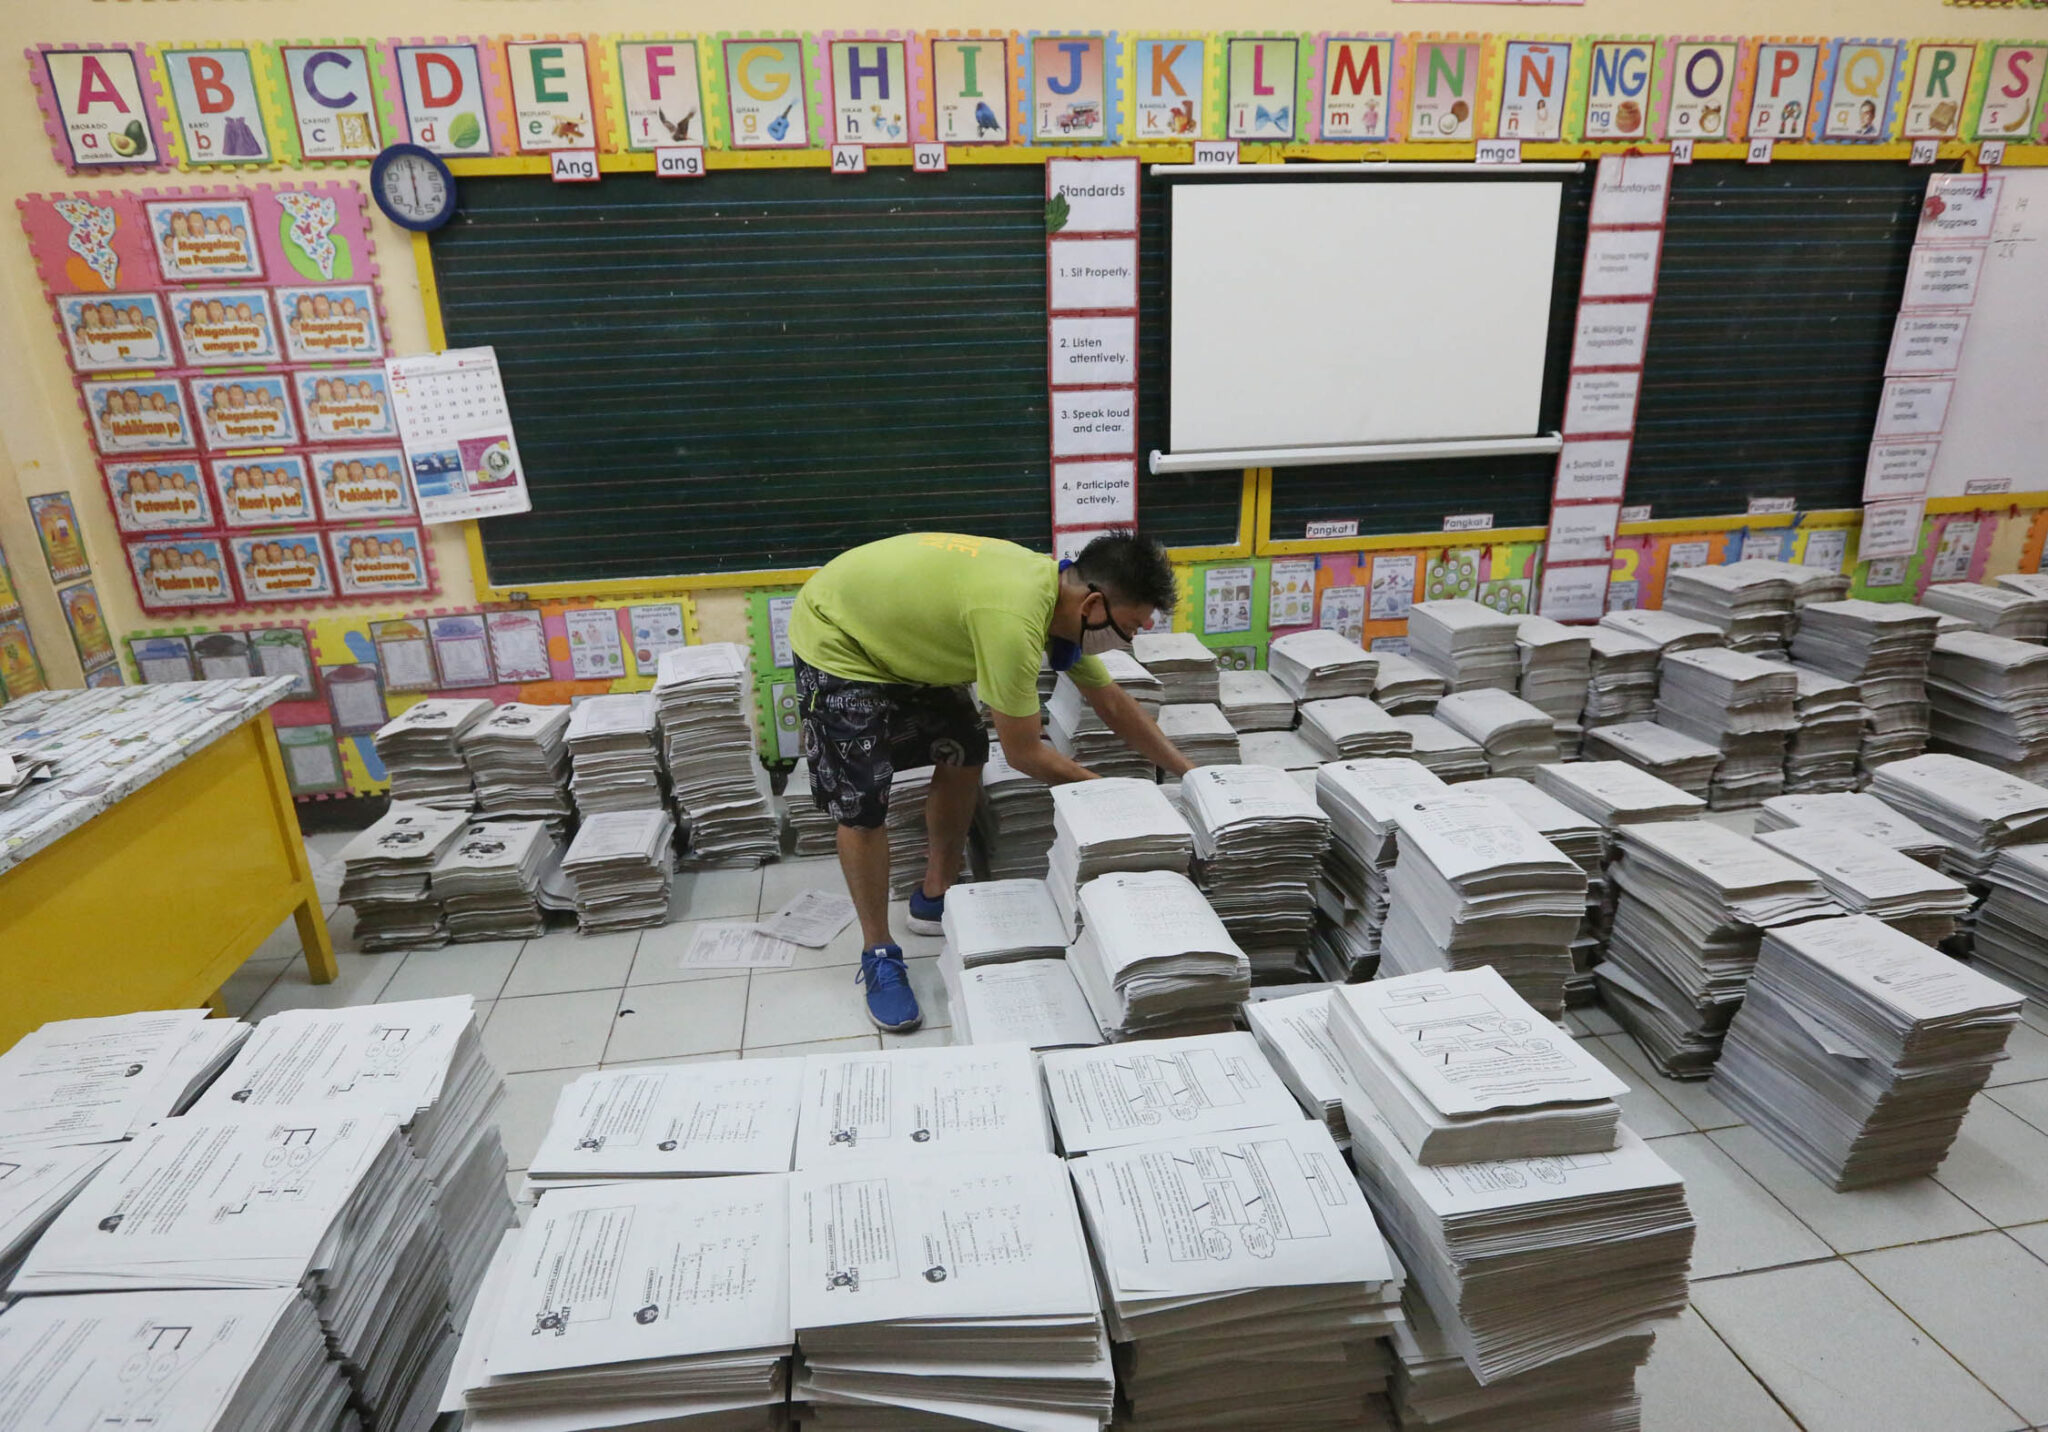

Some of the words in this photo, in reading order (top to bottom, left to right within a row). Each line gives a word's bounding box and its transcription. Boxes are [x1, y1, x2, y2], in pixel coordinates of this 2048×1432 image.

[529, 47, 569, 103] E
[645, 46, 676, 100] F
[737, 45, 791, 101] G
[848, 46, 890, 100] H
[957, 46, 983, 97] I
[1047, 43, 1089, 95] J
[1152, 44, 1187, 97] K
[1253, 45, 1275, 96] L
[1331, 45, 1382, 96] M
[1427, 47, 1467, 98] N
[1518, 46, 1555, 97] Ñ
[1592, 48, 1647, 97] NG
[1685, 48, 1724, 98] O
[1770, 50, 1799, 98] P
[1844, 48, 1885, 98] Q
[1925, 50, 1957, 98] R
[2001, 50, 2034, 98] S
[77, 56, 131, 114] A
[187, 56, 235, 114] B
[303, 51, 358, 109] C
[415, 52, 464, 109] D
[743, 114, 757, 133] g
[847, 115, 859, 133] h
[948, 112, 953, 131] i
[1042, 110, 1048, 129] j
[1147, 110, 1159, 128] k
[1331, 111, 1349, 126] m
[1420, 111, 1432, 126] n
[1508, 113, 1519, 130] ñ
[1590, 110, 1610, 127] ng
[1679, 112, 1690, 125] o
[1757, 110, 1770, 128] p
[1837, 110, 1849, 126] q
[1914, 111, 1923, 124] r
[1989, 110, 2000, 124] s
[421, 123, 436, 143] d
[529, 120, 543, 136] e
[642, 118, 650, 137] f
[81, 133, 99, 149] a
[195, 131, 212, 150] b
[312, 129, 326, 143] c
[1198, 150, 1236, 164] may
[1480, 145, 1516, 163] mga
[1752, 145, 1767, 158] at
[1912, 148, 1933, 164] Ng
[1982, 148, 2000, 164] ng
[556, 159, 594, 178] Ang
[661, 156, 699, 174] ang
[835, 152, 859, 170] Ay
[918, 152, 941, 169] ay
[1059, 184, 1125, 197] Standards
[1060, 268, 1068, 278] 1.
[1071, 267, 1083, 277] Sit
[1085, 267, 1131, 278] Properly.
[194, 327, 260, 339] Magandang
[301, 321, 363, 333] Magandang
[203, 340, 240, 352] umaga
[242, 340, 258, 353] po
[305, 334, 348, 348] tanghali
[350, 335, 364, 347] po
[1060, 338, 1070, 348] 2.
[1073, 338, 1102, 348] Listen
[1069, 352, 1129, 364] attentively.
[217, 409, 279, 422] Magandang
[319, 403, 380, 416] Magandang
[1061, 410, 1070, 420] 3.
[1073, 409, 1105, 420] Speak
[1107, 409, 1130, 418] loud
[167, 422, 180, 437] po
[260, 424, 275, 436] po
[358, 417, 371, 430] po
[1073, 424, 1093, 433] and
[1095, 424, 1125, 433] clear.
[1062, 482, 1072, 491] 4.
[1076, 480, 1130, 491] Participate
[384, 489, 398, 503] po
[1076, 495, 1120, 506] actively.
[183, 500, 196, 512] po
[1307, 525, 1349, 537] Pangkat
[1444, 518, 1484, 529] Pangkat
[1485, 517, 1491, 526] 2
[354, 562, 410, 573] Walang
[840, 743, 846, 753] 7
[863, 740, 871, 749] 8
